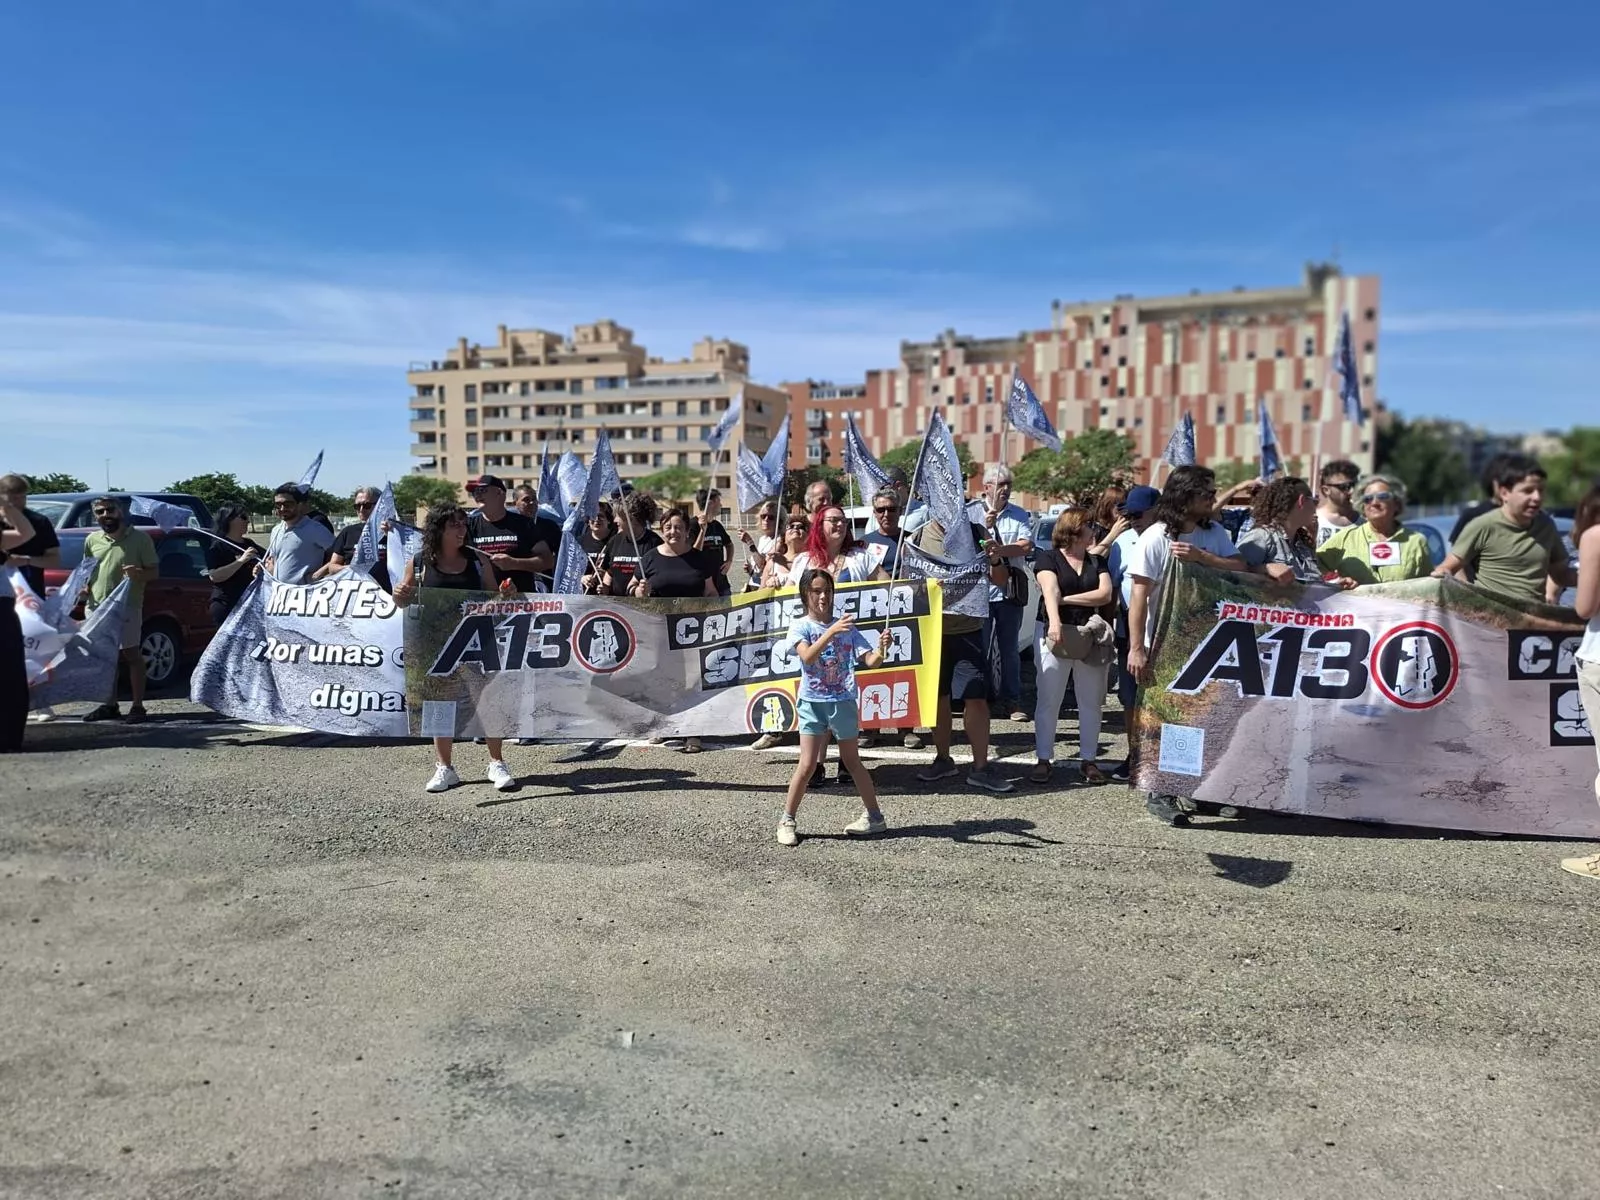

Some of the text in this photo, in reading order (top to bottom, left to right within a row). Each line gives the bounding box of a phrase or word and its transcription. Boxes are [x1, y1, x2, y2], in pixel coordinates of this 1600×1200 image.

[909, 557, 987, 575] MARTES NEGROS
[267, 580, 396, 619] MARTES
[467, 600, 564, 615] PLATAFORMA
[676, 586, 914, 646] CARREERA
[1220, 604, 1355, 628] PLATAFORMA
[308, 644, 383, 668] unas
